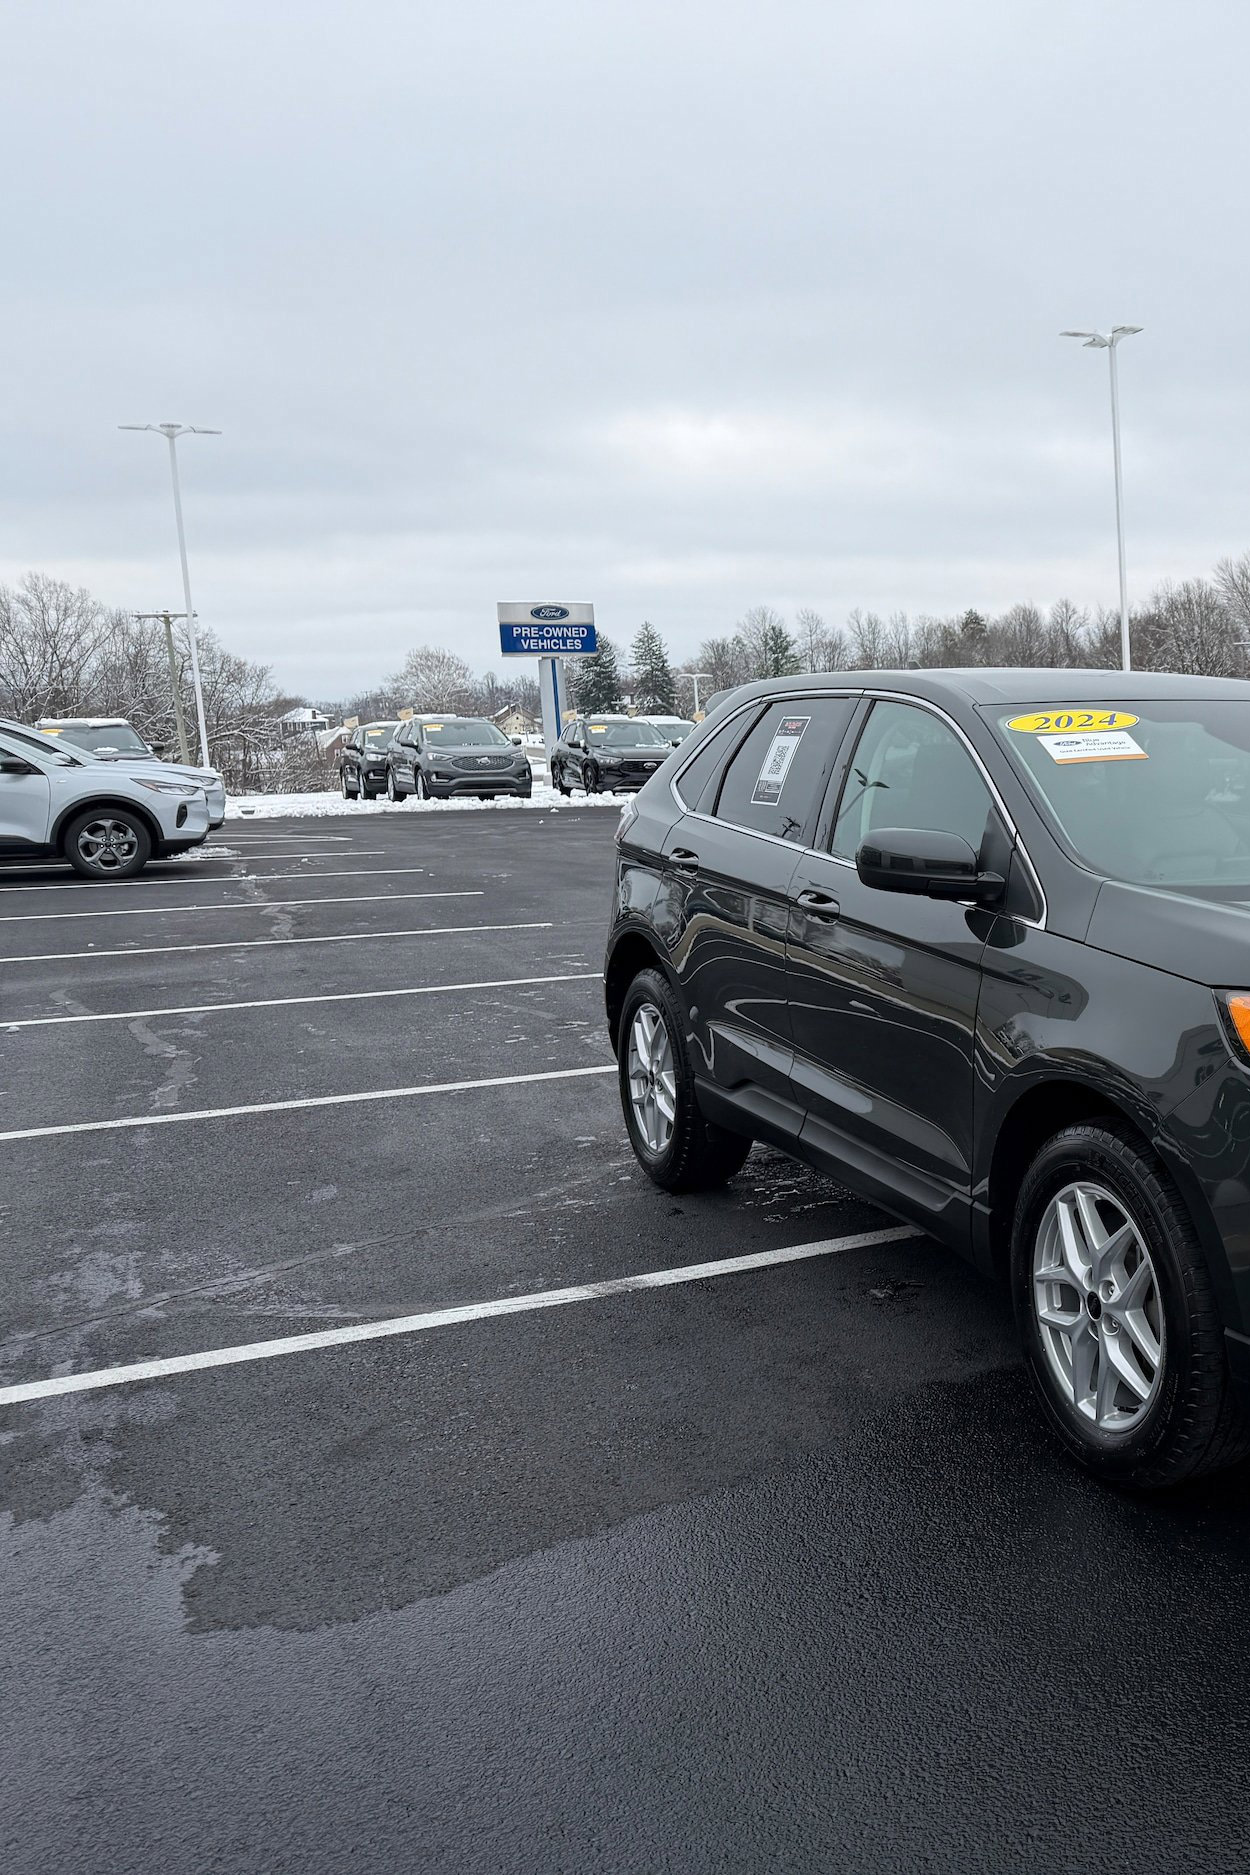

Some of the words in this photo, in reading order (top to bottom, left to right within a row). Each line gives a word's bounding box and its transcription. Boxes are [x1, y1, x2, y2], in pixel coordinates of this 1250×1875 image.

[512, 626, 588, 638] PRE-OWNED
[520, 638, 582, 650] VEHICLES
[1033, 712, 1118, 731] 2024
